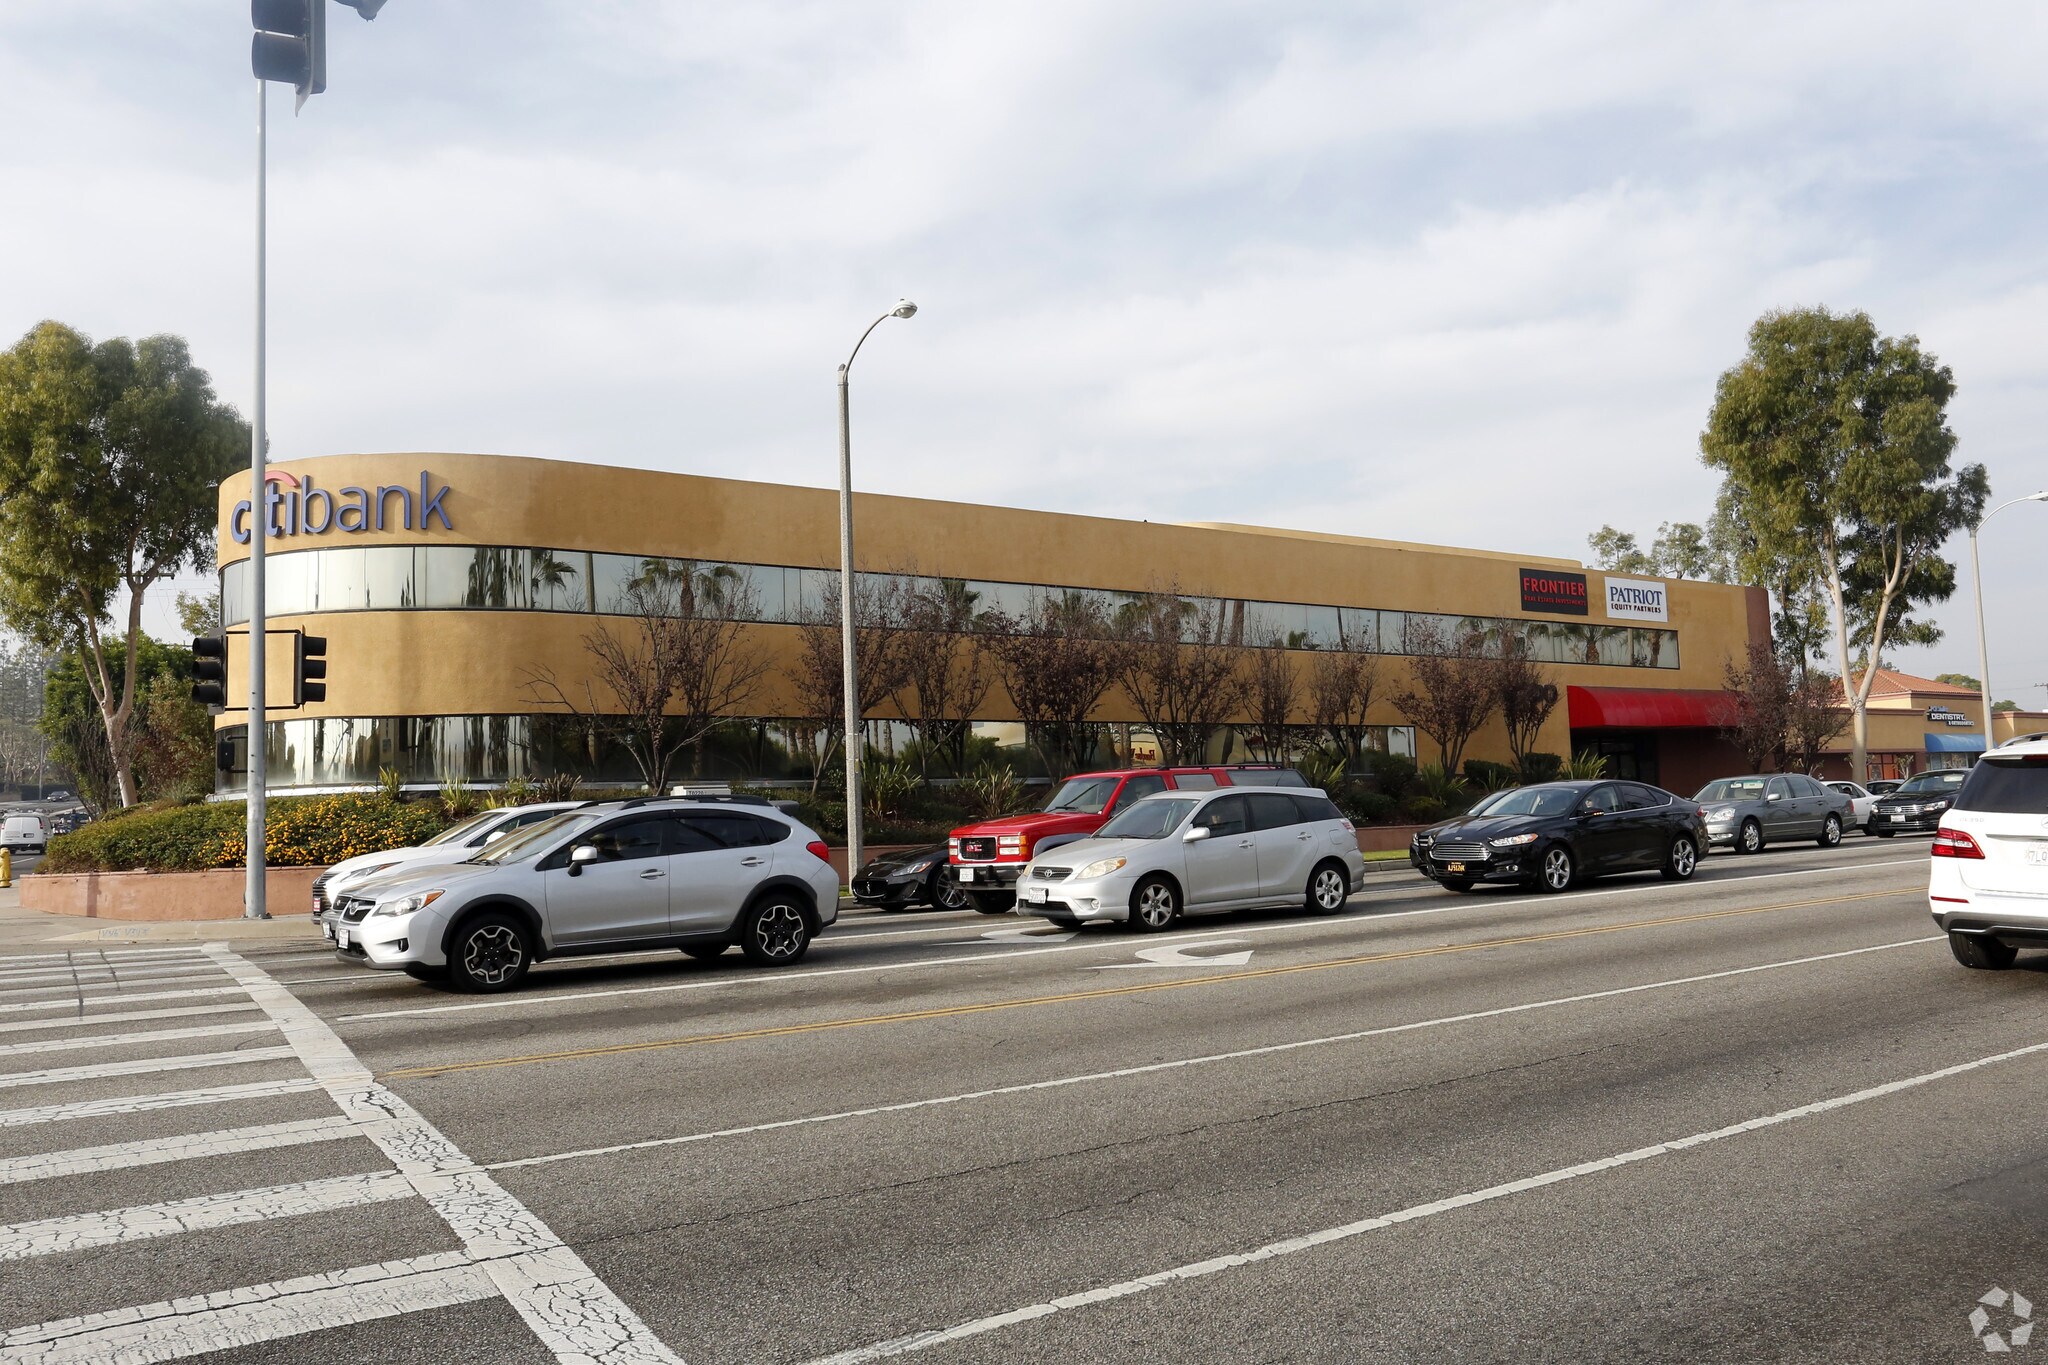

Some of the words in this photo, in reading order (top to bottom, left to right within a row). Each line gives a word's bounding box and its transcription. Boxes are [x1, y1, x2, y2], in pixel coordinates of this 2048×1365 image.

[231, 470, 452, 544] ctibank
[1522, 577, 1585, 596] FRONTIER
[1610, 586, 1662, 605] PATRIOT
[1611, 603, 1632, 611] EQUITY
[1633, 605, 1661, 613] PARTNERS
